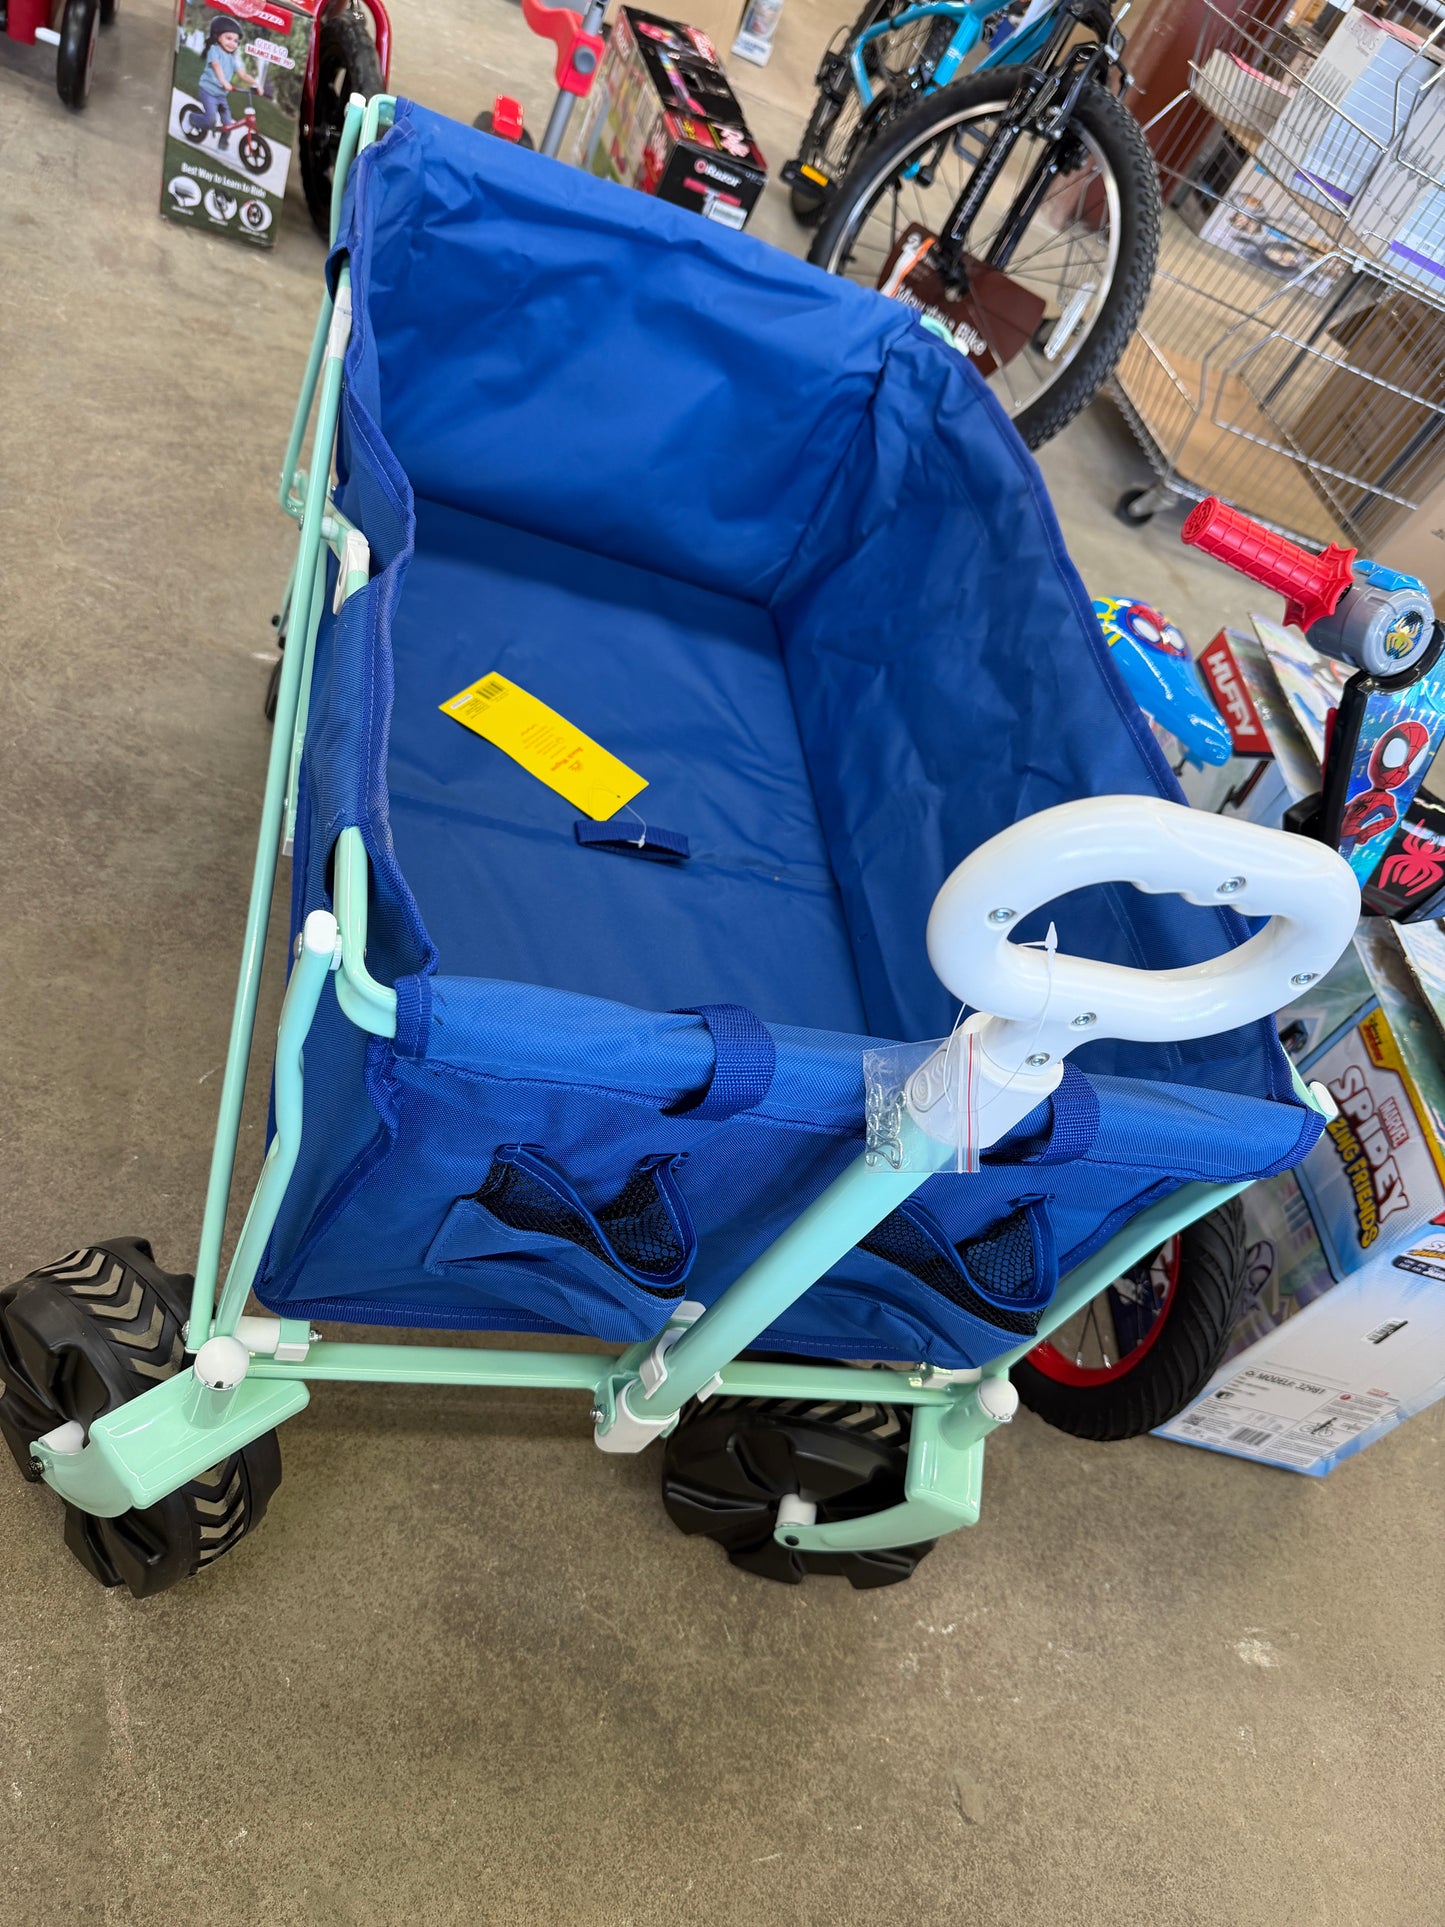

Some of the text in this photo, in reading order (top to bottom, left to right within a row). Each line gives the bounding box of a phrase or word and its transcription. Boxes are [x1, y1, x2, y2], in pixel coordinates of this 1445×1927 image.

[181, 162, 199, 176] Best
[199, 168, 214, 183] Way
[223, 176, 242, 190] Learn
[250, 185, 267, 199] Ride
[954, 321, 987, 355] Bike
[1207, 649, 1257, 735] HUFFY
[1327, 1064, 1410, 1222] SPIDEY
[1378, 1098, 1408, 1147] MARVEL
[1346, 1156, 1380, 1247] FRIENDS
